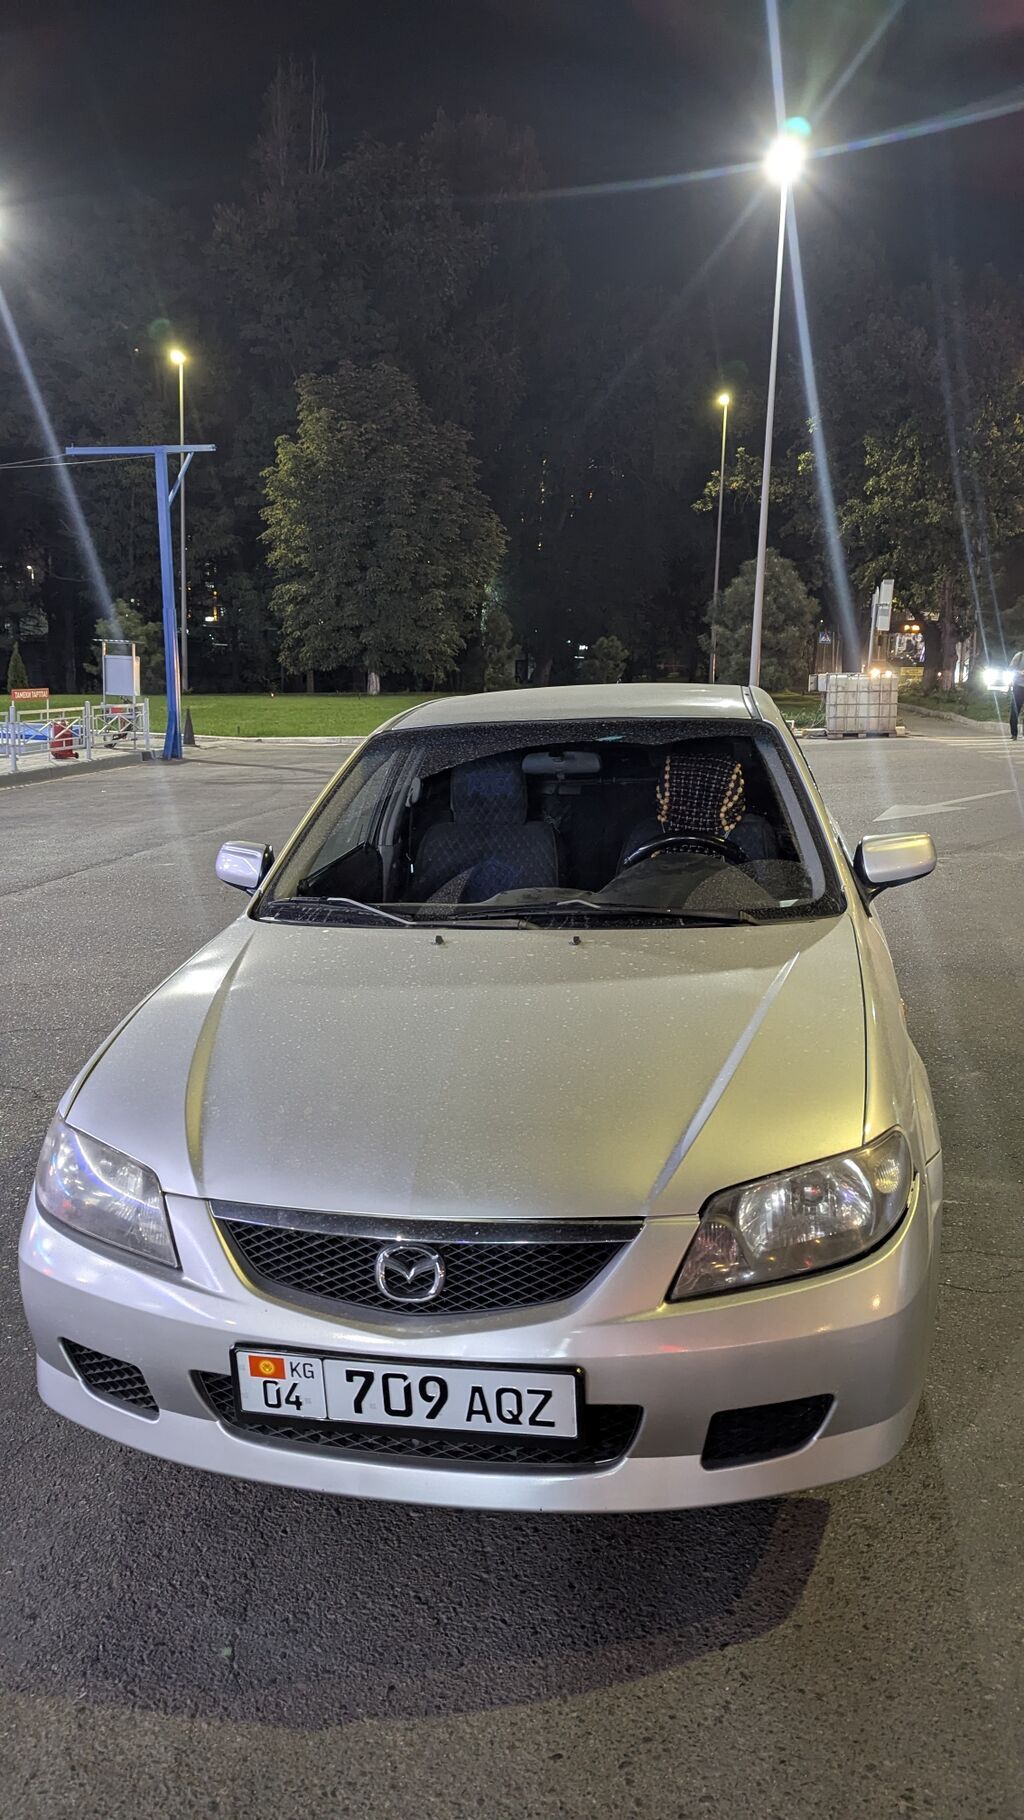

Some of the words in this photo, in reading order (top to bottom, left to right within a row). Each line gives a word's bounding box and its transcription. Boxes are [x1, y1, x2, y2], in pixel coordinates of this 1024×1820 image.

[289, 1361, 315, 1379] KG
[262, 1379, 303, 1411] 04
[345, 1369, 449, 1420] 709
[465, 1385, 556, 1428] AQZ
